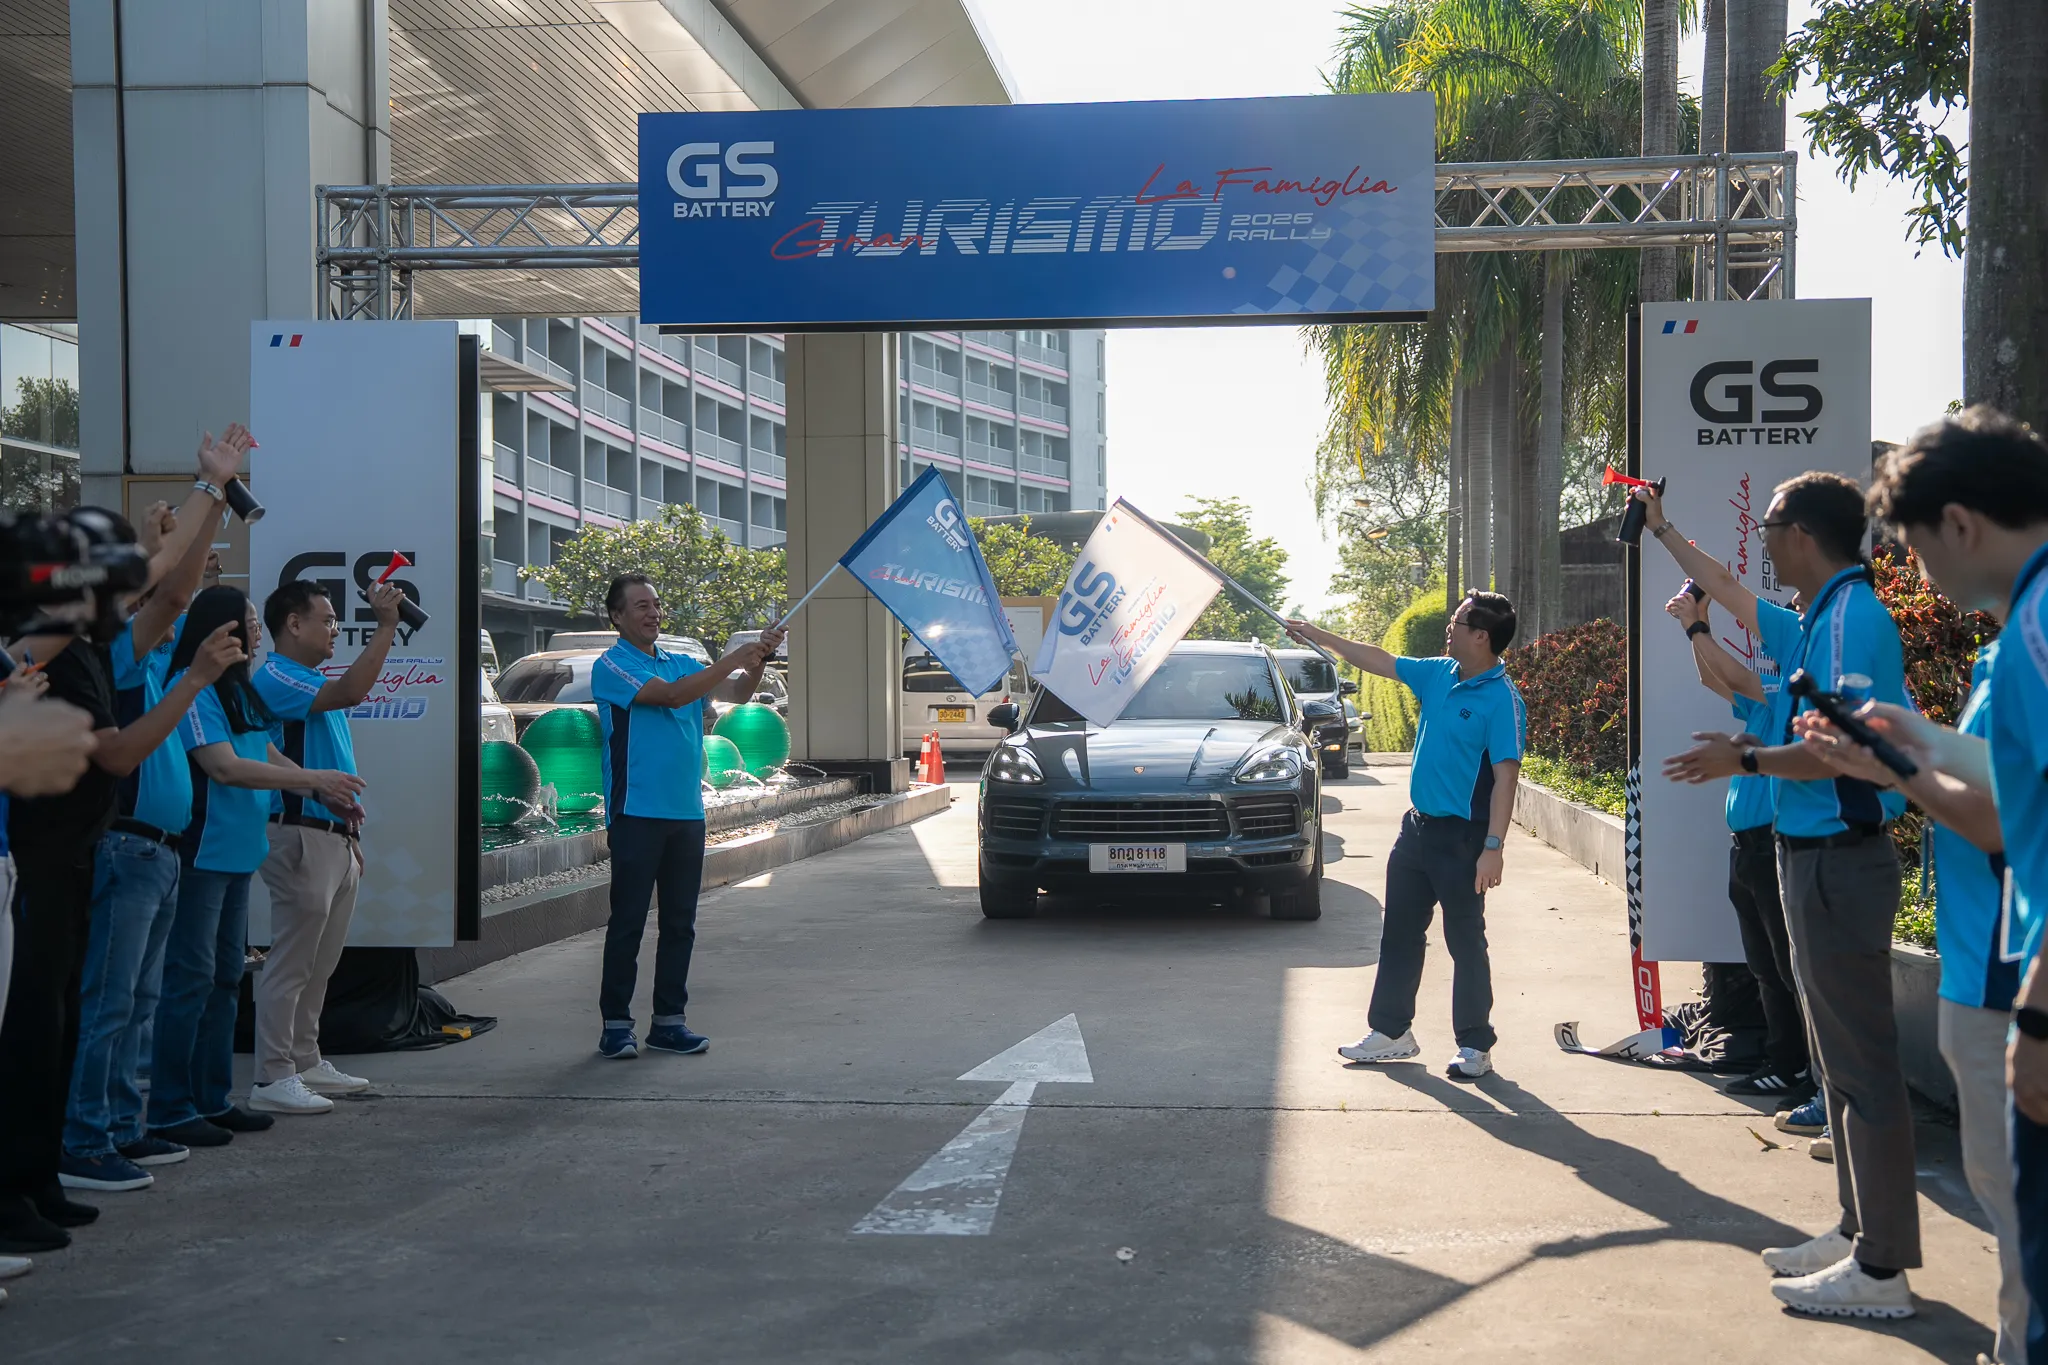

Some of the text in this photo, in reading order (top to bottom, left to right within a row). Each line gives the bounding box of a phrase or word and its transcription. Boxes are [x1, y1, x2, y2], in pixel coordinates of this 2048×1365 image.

[666, 141, 779, 199] GS
[1135, 162, 1398, 206] La Famiglia
[673, 201, 776, 218] BATTERY
[805, 192, 1225, 258] TURISMO
[1230, 212, 1314, 227] 2026
[771, 218, 936, 260] Gran
[1227, 227, 1332, 242] RALLY
[1690, 359, 1823, 424] GS
[1697, 427, 1819, 446] BATTERY
[926, 515, 963, 553] BATTERY
[1059, 561, 1116, 636] GS
[1080, 585, 1127, 646] BATTERY
[1088, 656, 1112, 686] La
[1109, 583, 1167, 656] Famiglia
[1119, 618, 1157, 669] Gran
[1136, 847, 1166, 860] 8118
